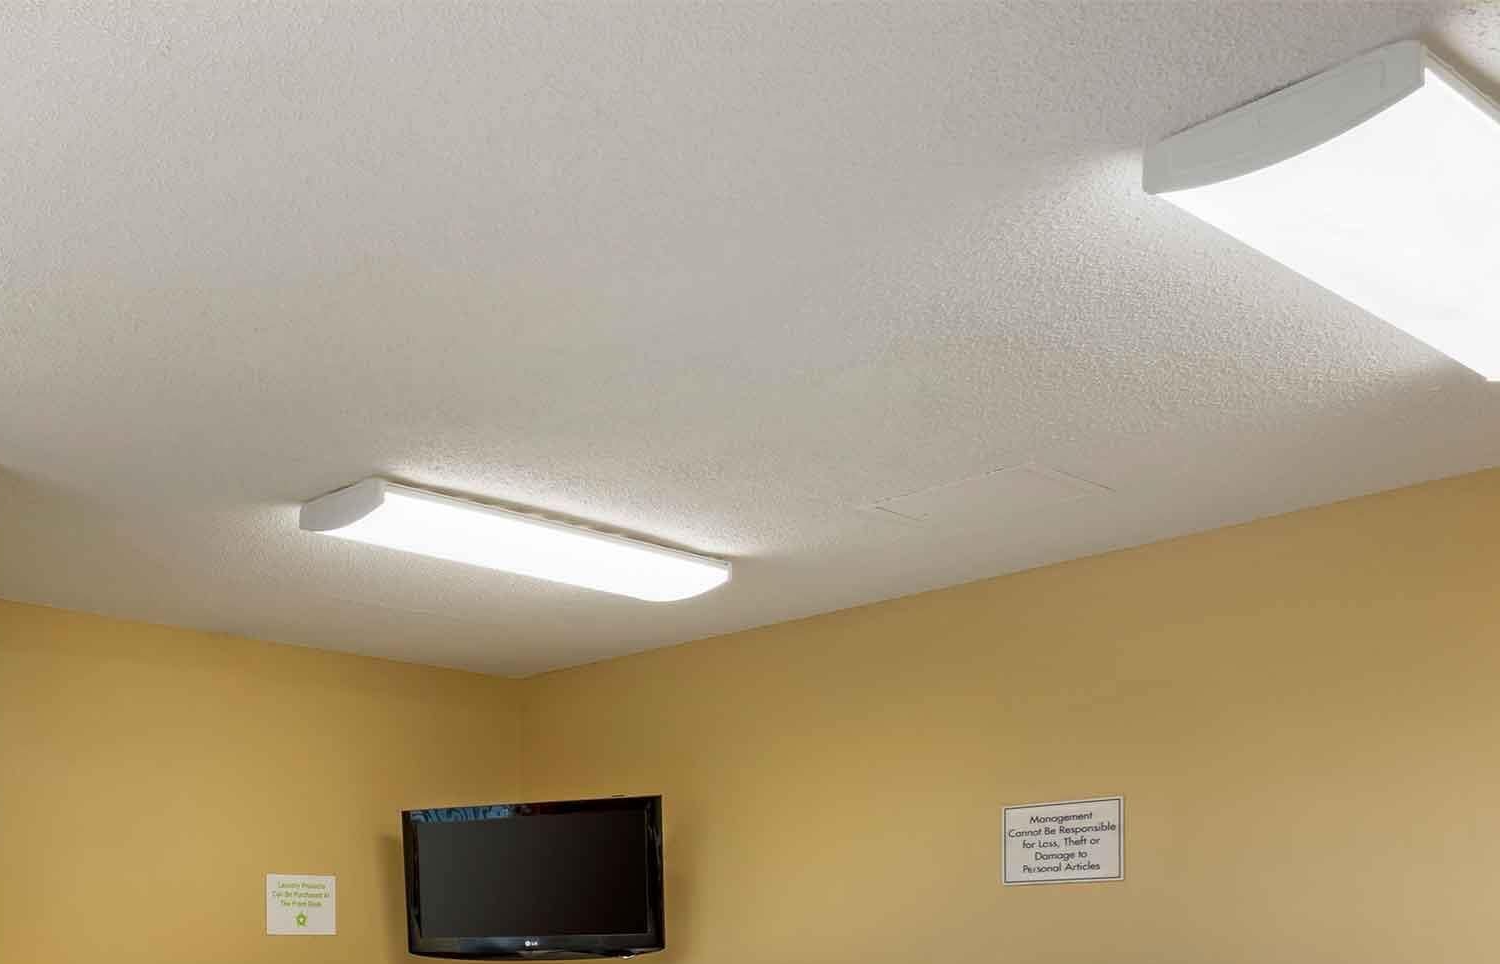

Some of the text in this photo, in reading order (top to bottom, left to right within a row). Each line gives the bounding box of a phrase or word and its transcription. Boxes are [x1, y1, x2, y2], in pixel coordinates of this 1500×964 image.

[1029, 812, 1093, 824] Management
[1008, 820, 1117, 838] Cannot Be Responsible
[1022, 840, 1036, 849] for
[1038, 839, 1060, 849] Loss,
[1063, 835, 1087, 847] Theft
[1034, 850, 1088, 861] Damage to
[1022, 860, 1101, 874] Personal Articles
